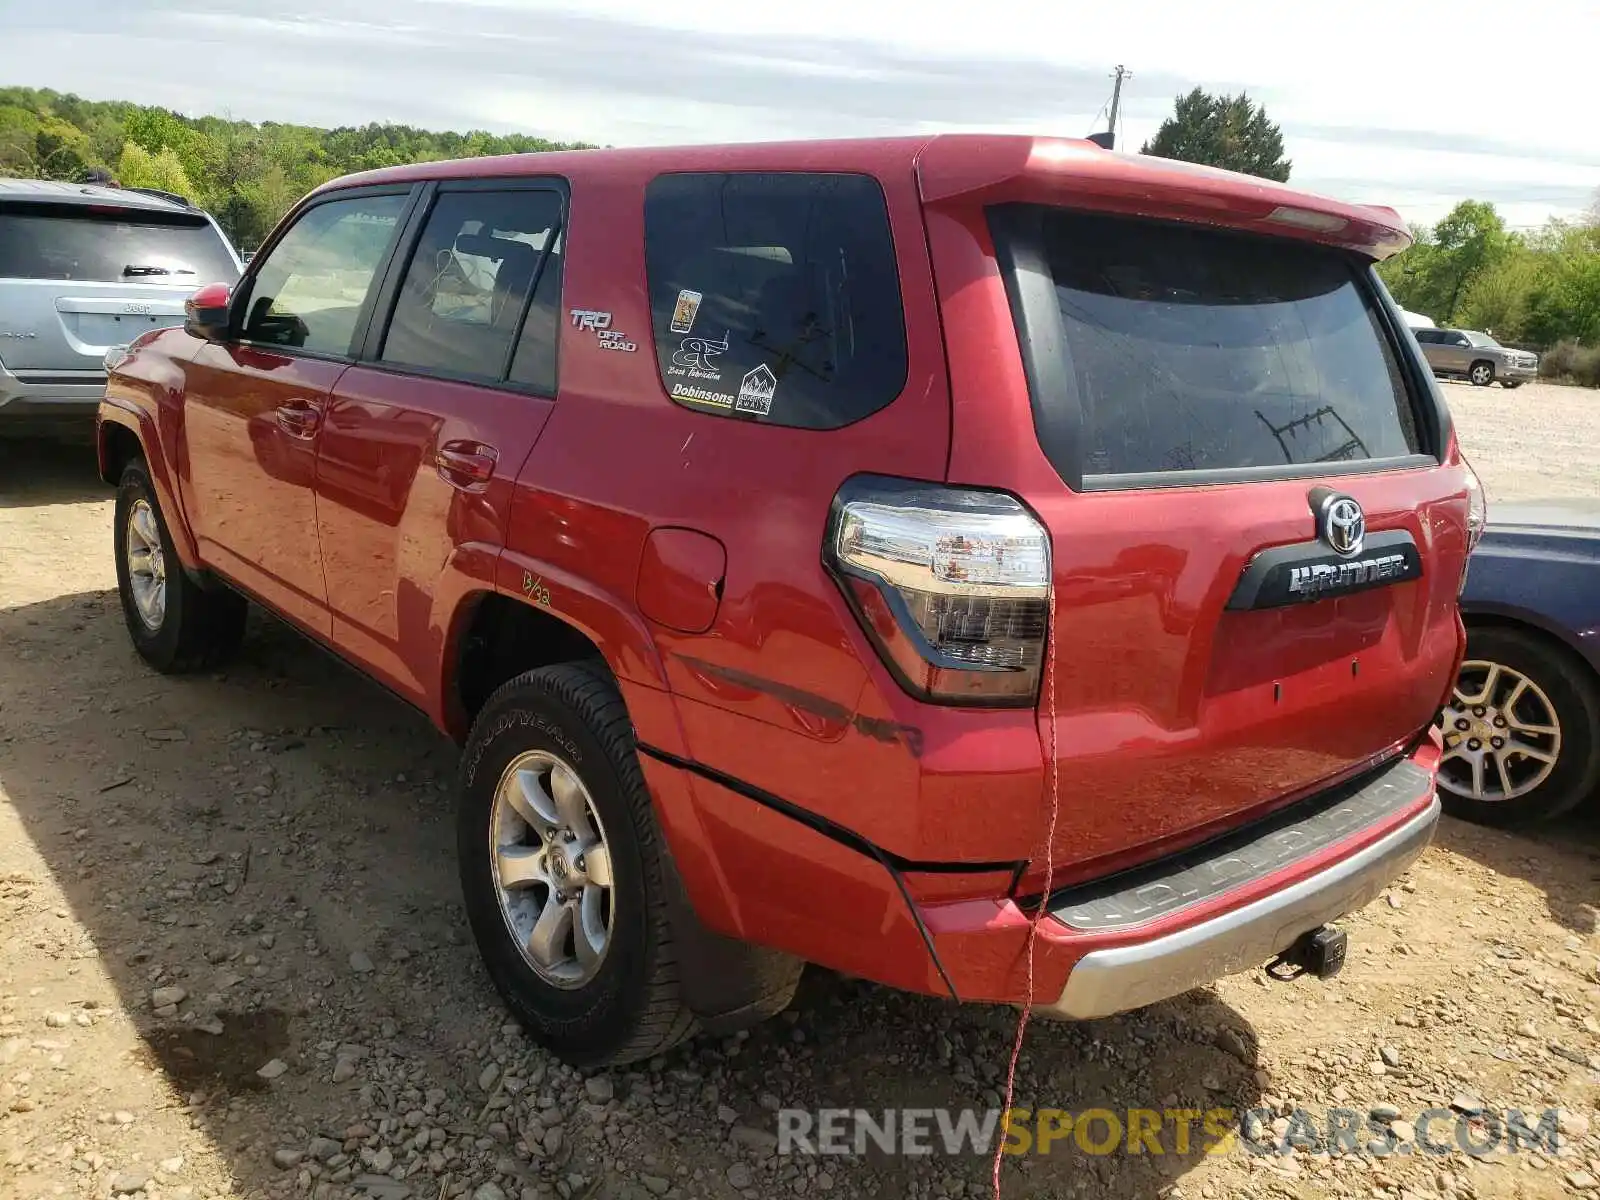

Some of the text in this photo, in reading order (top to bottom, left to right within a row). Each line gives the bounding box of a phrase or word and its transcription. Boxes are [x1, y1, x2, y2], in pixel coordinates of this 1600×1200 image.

[569, 309, 612, 331] TRD
[597, 330, 626, 341] OFF
[599, 339, 638, 352] ROAD
[672, 383, 736, 405] Dobinsons
